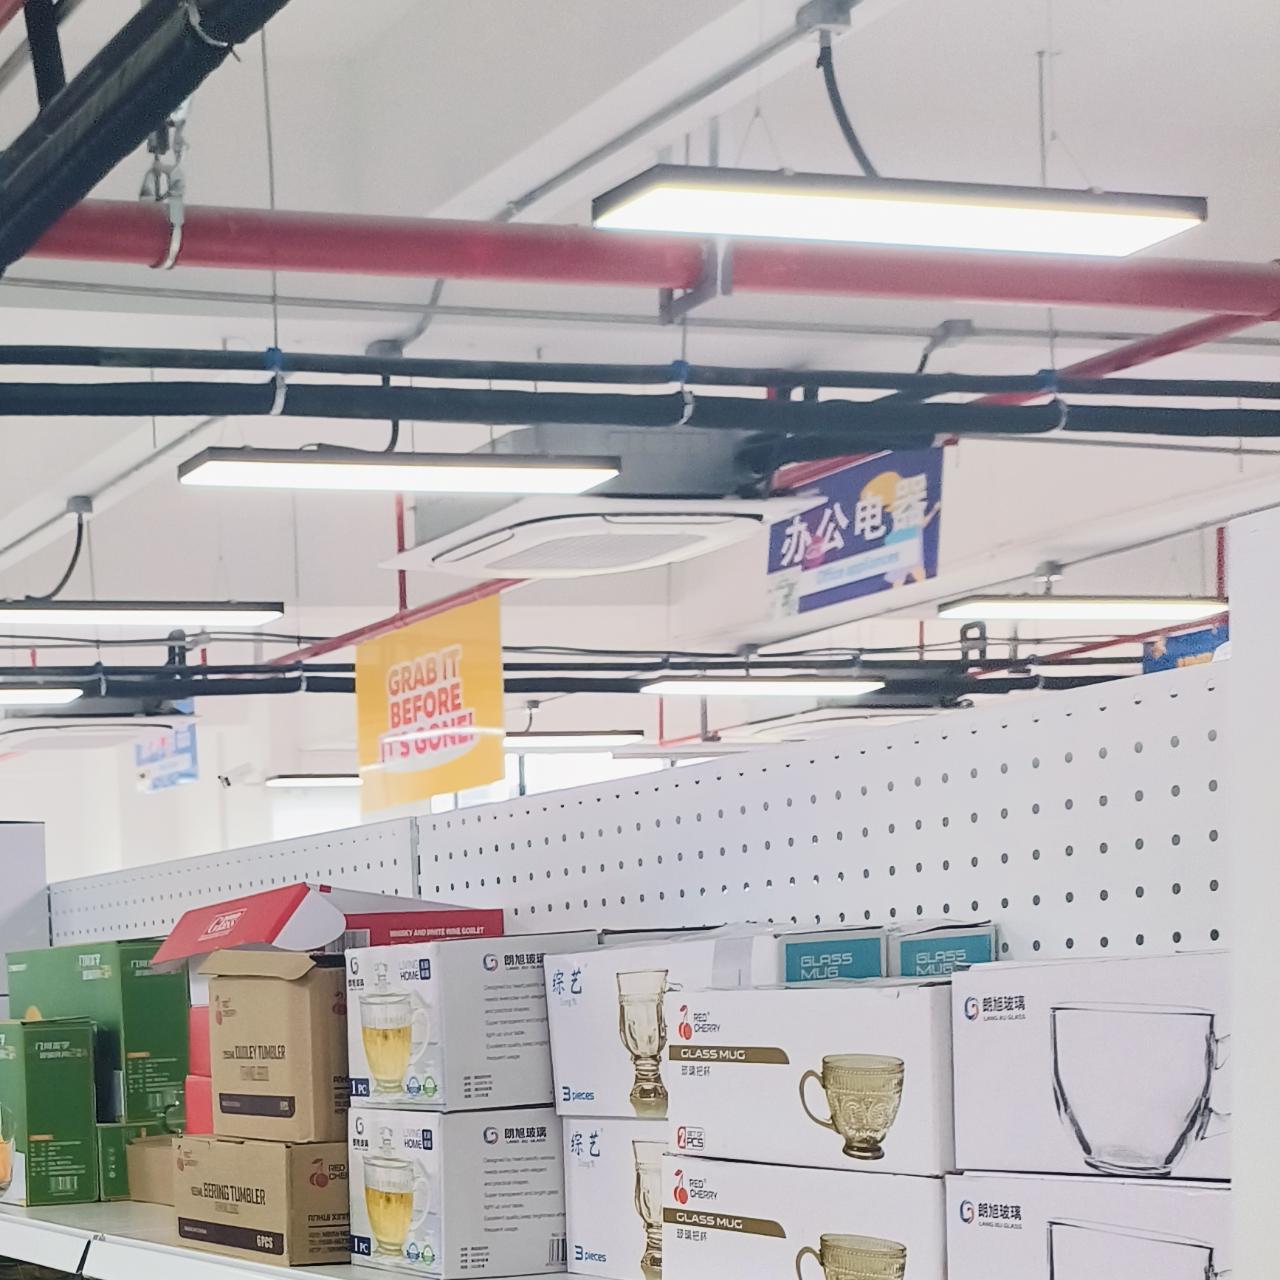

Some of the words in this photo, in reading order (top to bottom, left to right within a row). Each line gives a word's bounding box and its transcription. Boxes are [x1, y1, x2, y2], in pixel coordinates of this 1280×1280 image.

[780, 473, 928, 566] 办公电器
[388, 656, 437, 696] GRAB
[443, 648, 461, 680] IT
[390, 683, 462, 729] BEFORE
[800, 953, 853, 968] GLASS
[916, 949, 967, 963] GLASS
[800, 966, 839, 980] MUG
[916, 963, 953, 976] MUG
[982, 995, 1026, 1012] 朗旭玻璃
[694, 1023, 721, 1033] CHERRY
[680, 1048, 718, 1060] GLASS
[719, 1049, 746, 1060] MUG
[562, 1086, 571, 1102] 3
[572, 1090, 595, 1102] pieces
[504, 1126, 547, 1139] 朗旭玻璃
[678, 1126, 686, 1148] 2
[686, 1137, 704, 1148] PCS
[328, 1164, 346, 1173] RED
[328, 1172, 348, 1180] CHE
[689, 1179, 704, 1189] RED
[203, 1182, 229, 1201] BERING
[229, 1185, 266, 1206] TUMBLER
[689, 1189, 718, 1200] CHERRY
[978, 1203, 1022, 1220] 朗旭玻璃
[676, 1212, 715, 1226] GLASS
[716, 1217, 743, 1230] MUG
[256, 1235, 273, 1249] 6PCS
[574, 1245, 584, 1261] 3
[584, 1251, 607, 1263] pieces
